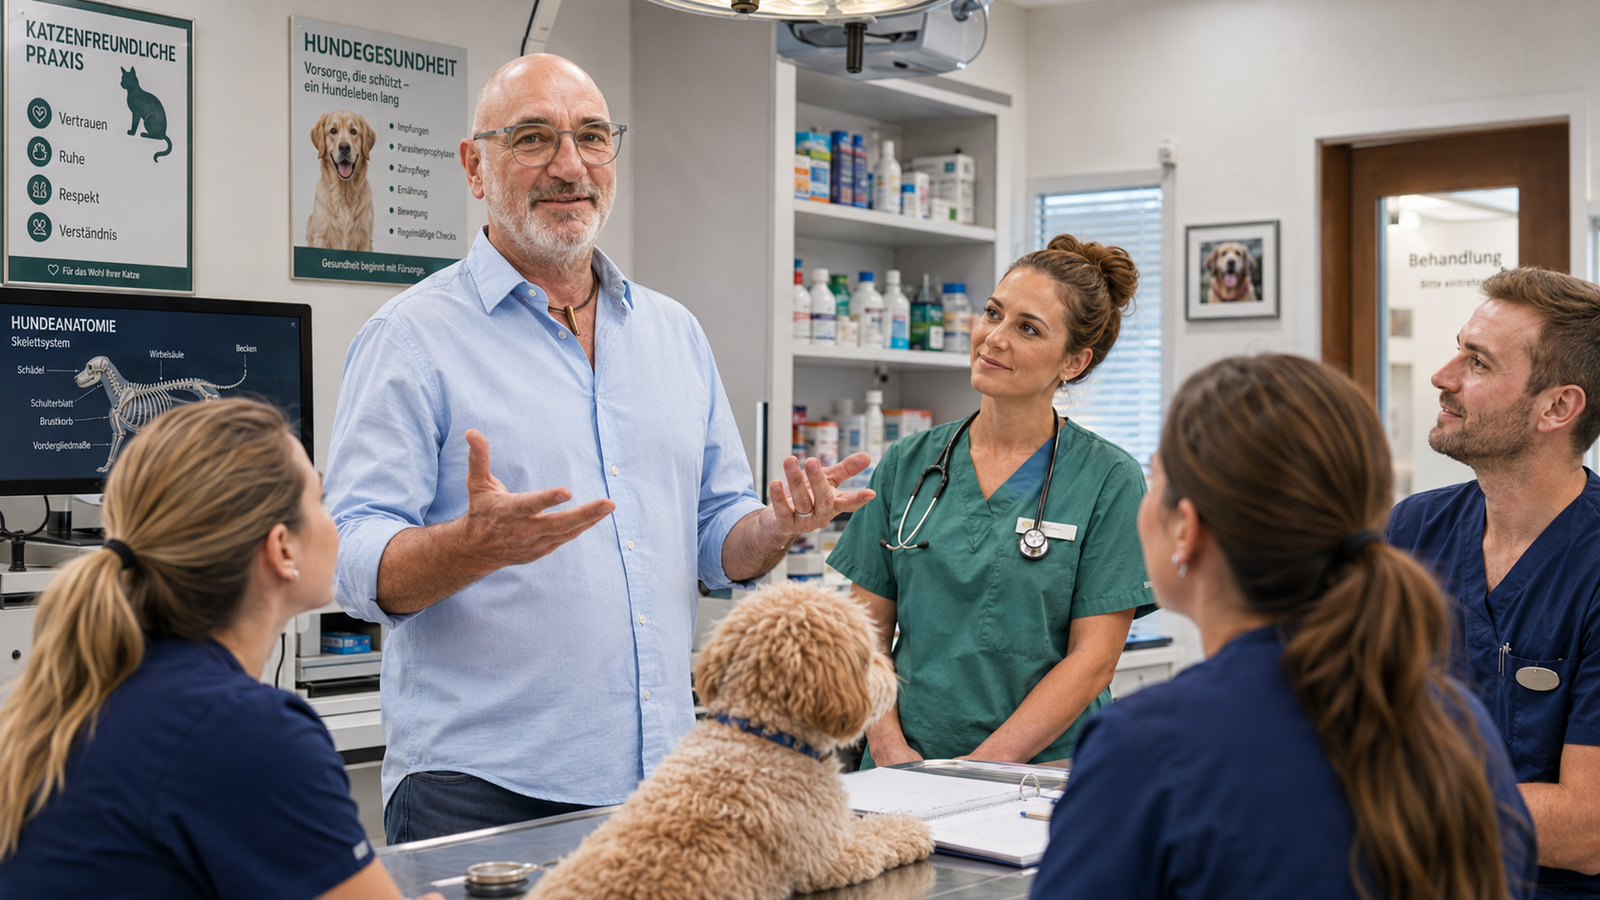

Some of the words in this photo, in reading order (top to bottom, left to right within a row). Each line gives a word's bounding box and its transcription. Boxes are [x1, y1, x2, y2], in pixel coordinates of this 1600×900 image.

[26, 19, 176, 62] KATZENFREUNDLICHE
[26, 45, 84, 71] PRAXIS
[304, 32, 457, 77] HUNDEGESUNDHEIT
[304, 61, 350, 83] Vorsorge,
[352, 70, 367, 83] die
[369, 74, 402, 89] schützt
[304, 80, 319, 93] ein
[322, 82, 378, 102] Hundeleben
[380, 91, 399, 108] lang
[59, 112, 108, 130] Vertrauen
[397, 122, 429, 137] Impfungen
[59, 150, 85, 165] Ruhe
[397, 163, 430, 178] Zahnpflege
[59, 188, 100, 205] Respekt
[397, 184, 428, 199] Ernährung
[397, 206, 428, 220] Bewegung
[59, 224, 118, 241] Verständnis
[1408, 250, 1502, 267] Behandlung
[62, 266, 74, 276] Für
[74, 267, 87, 277] das
[88, 268, 104, 278] Wohl
[105, 269, 121, 279] Ihrer
[121, 270, 140, 280] Katze
[321, 258, 359, 270] Gesundheit
[360, 261, 385, 273] beginnt
[386, 263, 397, 273] mit
[397, 264, 426, 277] Fürsorge.
[11, 315, 116, 333] HUNDEANATOMIE
[11, 335, 71, 350] Skelettsystem
[149, 350, 185, 359] Wirbelsäule
[17, 365, 45, 375] Schädel
[30, 398, 74, 408] Schulterblatt
[39, 416, 74, 426] Brustkorb
[32, 440, 91, 452] Vordergliedmaße
